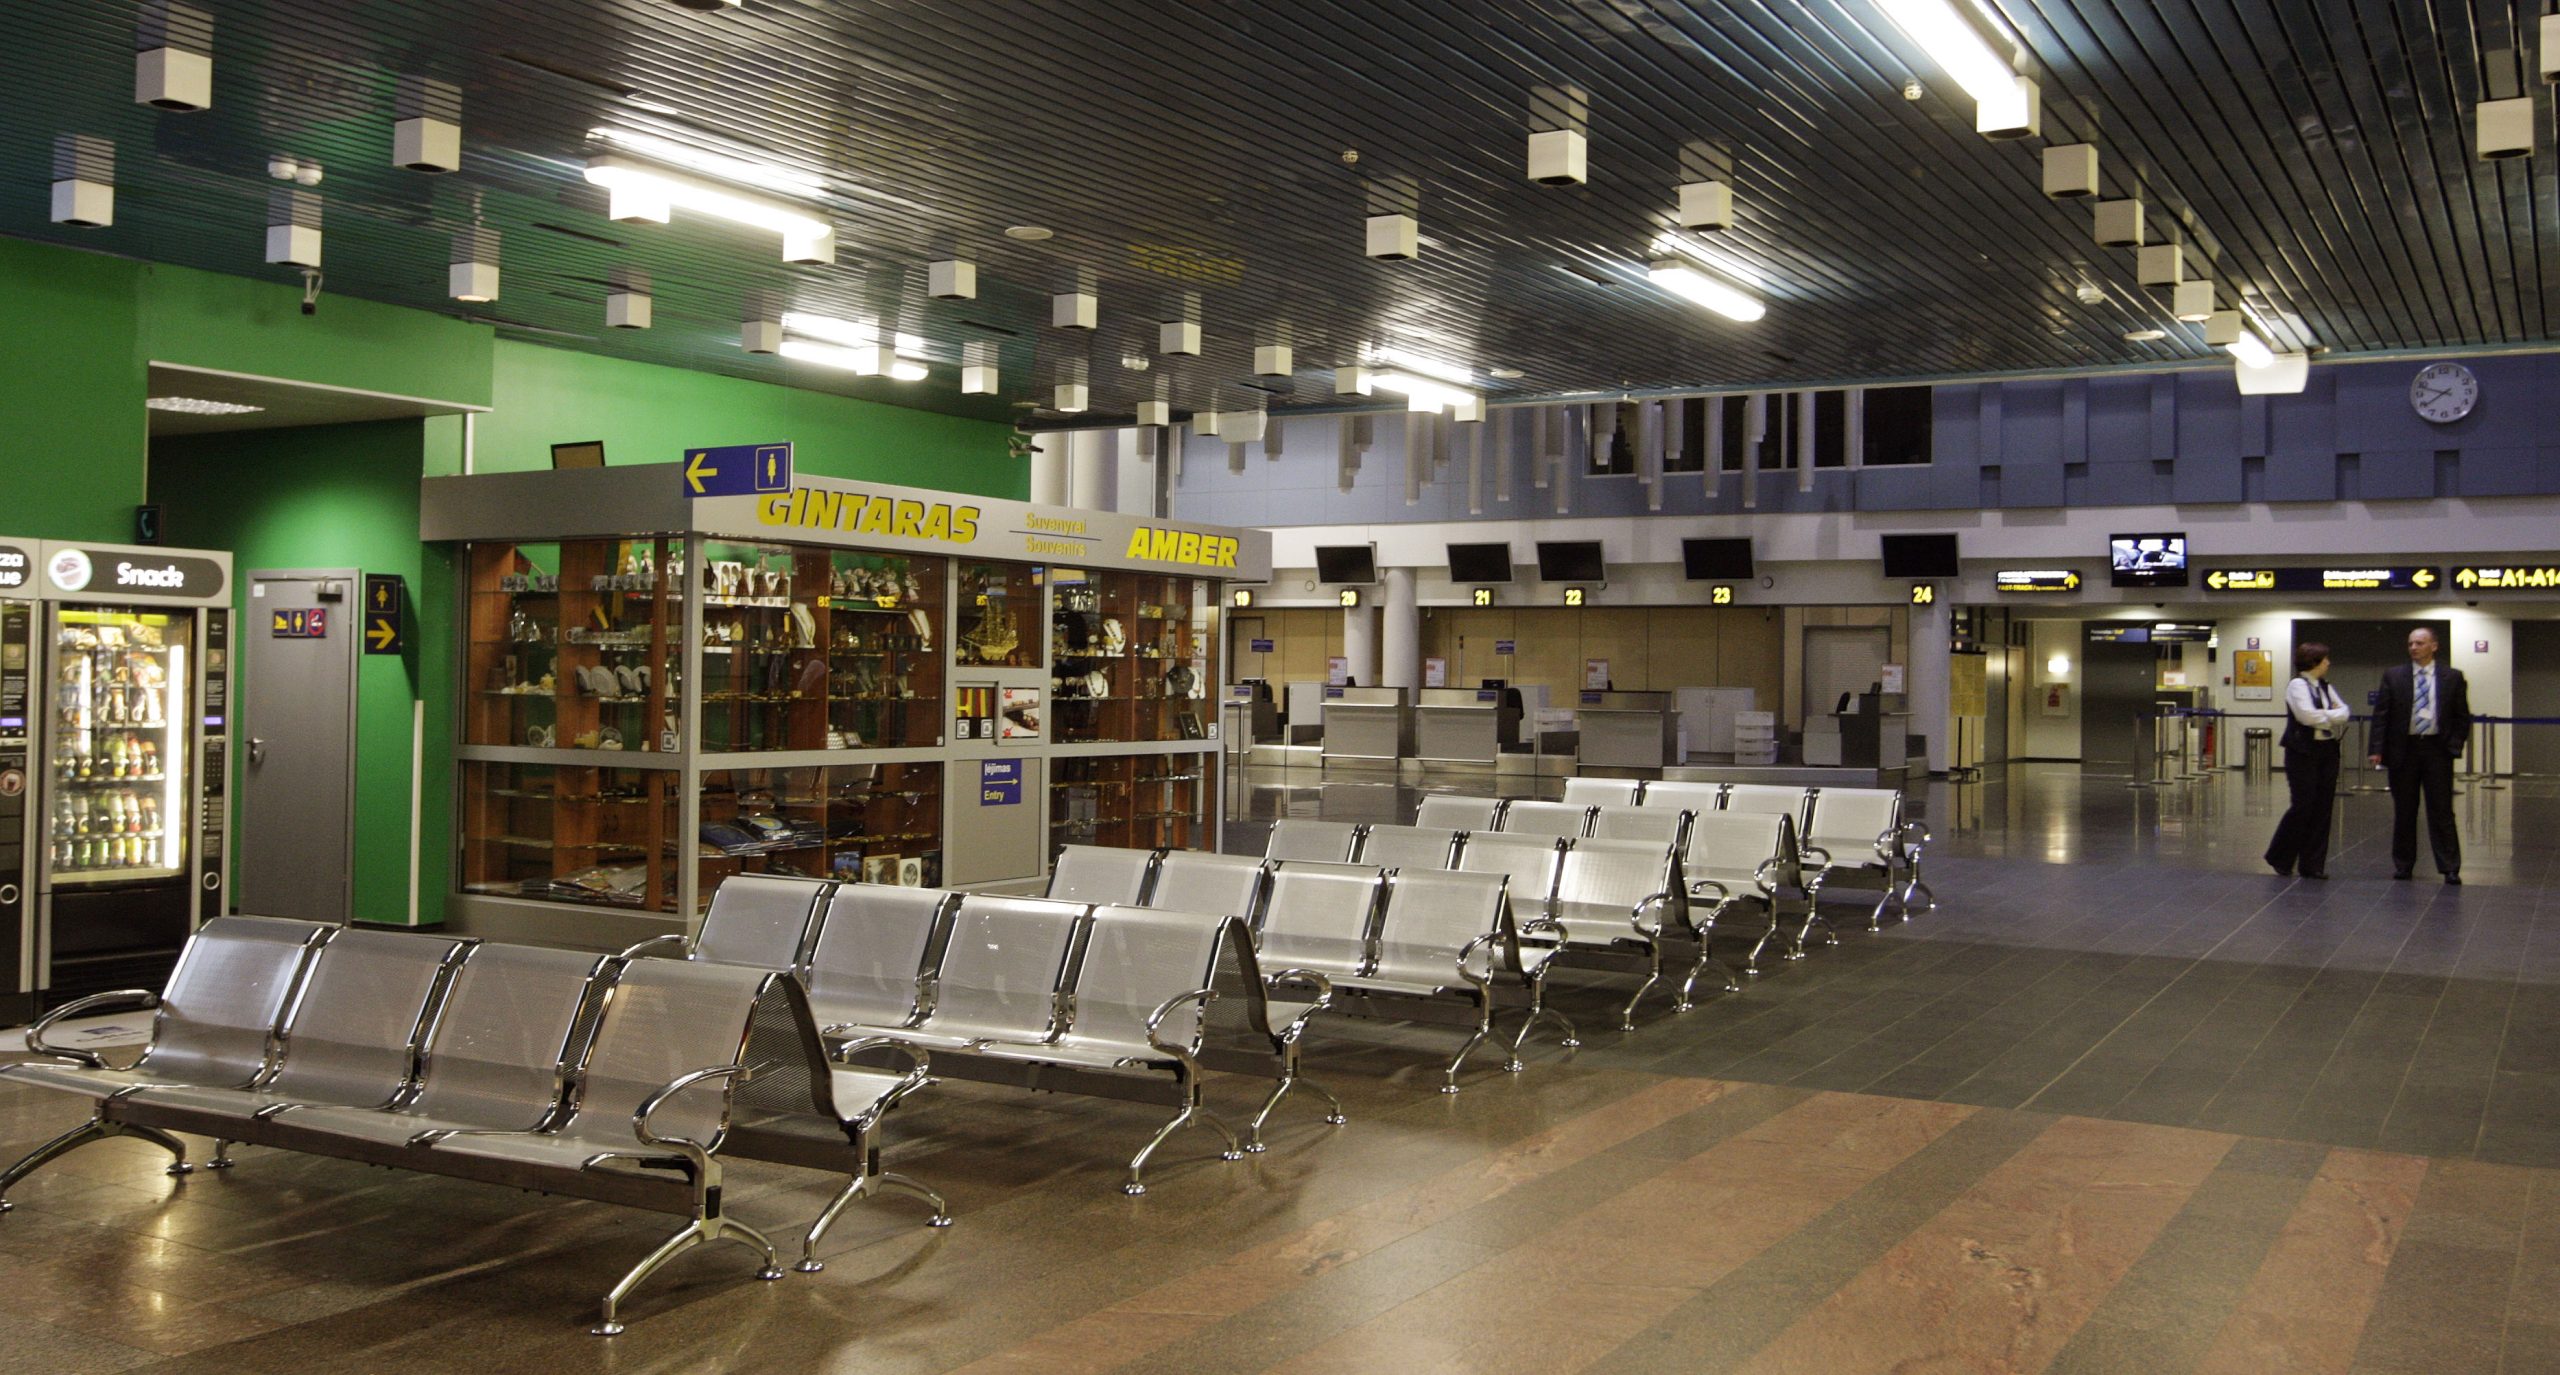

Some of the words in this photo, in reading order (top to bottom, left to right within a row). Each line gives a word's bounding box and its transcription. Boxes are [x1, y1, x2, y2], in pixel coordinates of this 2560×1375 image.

[756, 488, 980, 544] GINTARAS
[1026, 512, 1087, 534] Suvenyrai
[1026, 536, 1087, 557] Souvenirs
[1126, 526, 1239, 569] AMBER
[117, 562, 184, 588] Snack
[1235, 591, 1249, 606] 19
[1341, 591, 1356, 606] 20
[1475, 590, 1490, 605] 21
[1565, 589, 1582, 605] 22
[1713, 587, 1730, 604] 23
[1913, 586, 1932, 603] 24
[985, 790, 1004, 802] Entry
